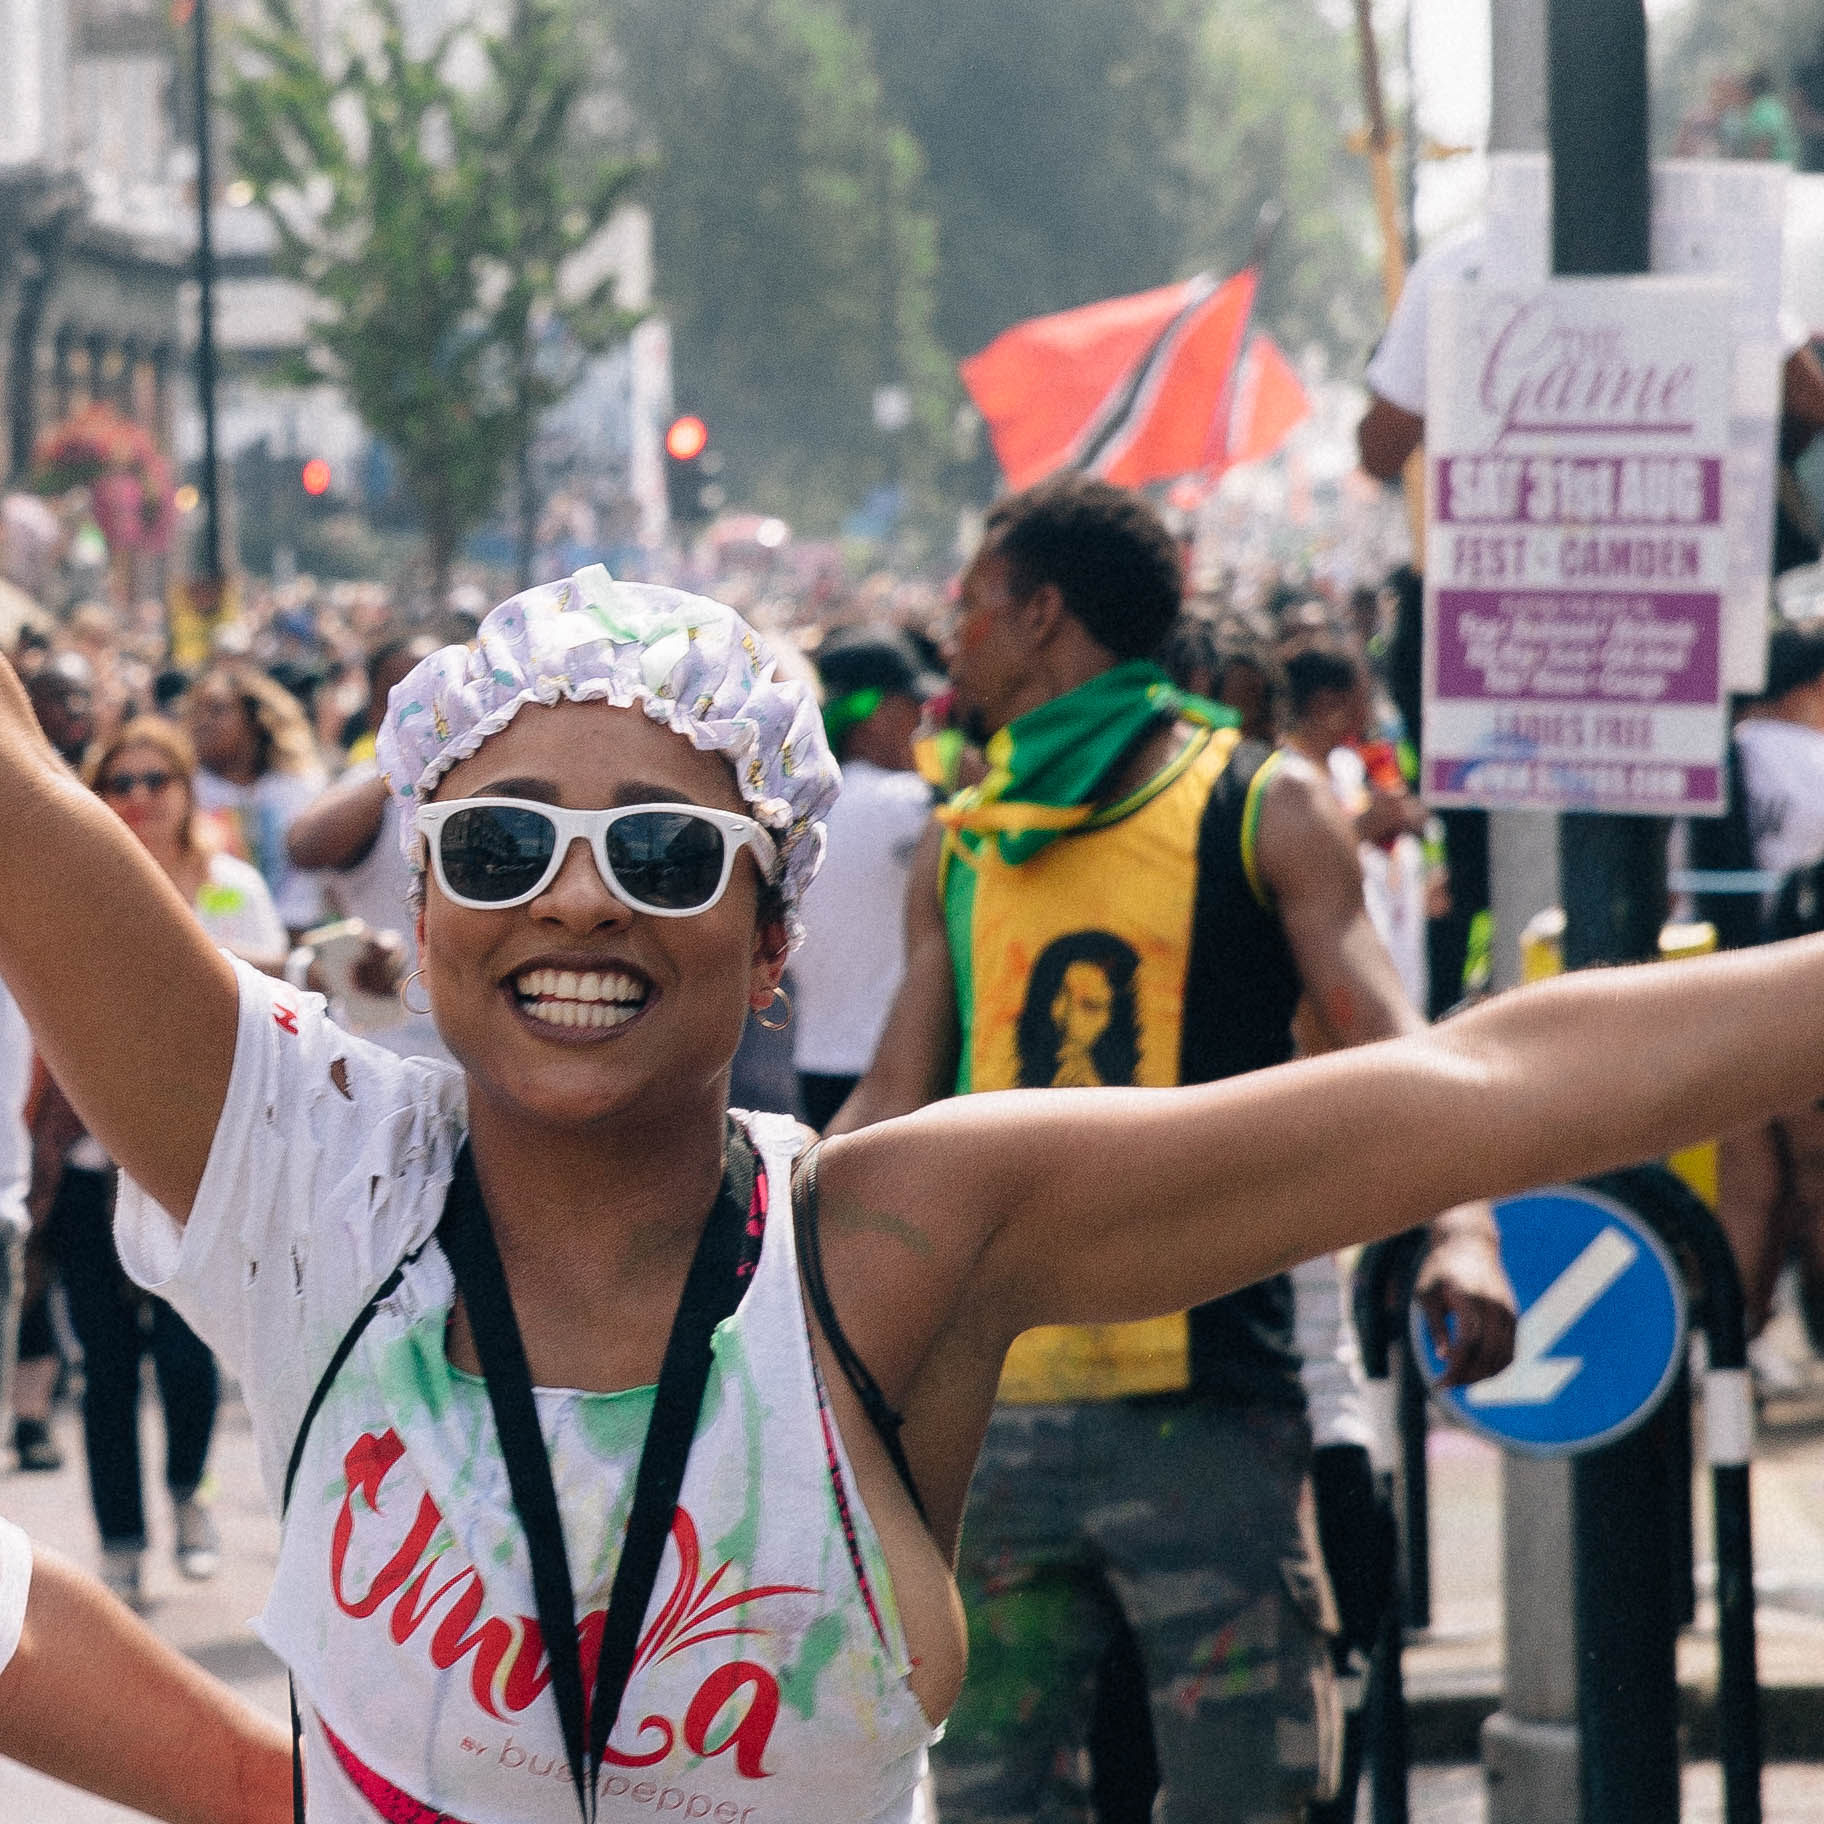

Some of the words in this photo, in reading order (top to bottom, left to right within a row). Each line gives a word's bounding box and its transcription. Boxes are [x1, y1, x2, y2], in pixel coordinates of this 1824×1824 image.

[1474, 294, 1697, 456] Game
[1453, 535, 1526, 578] FEST
[1560, 536, 1701, 579] CAMDEN
[1593, 715, 1653, 750] FREE
